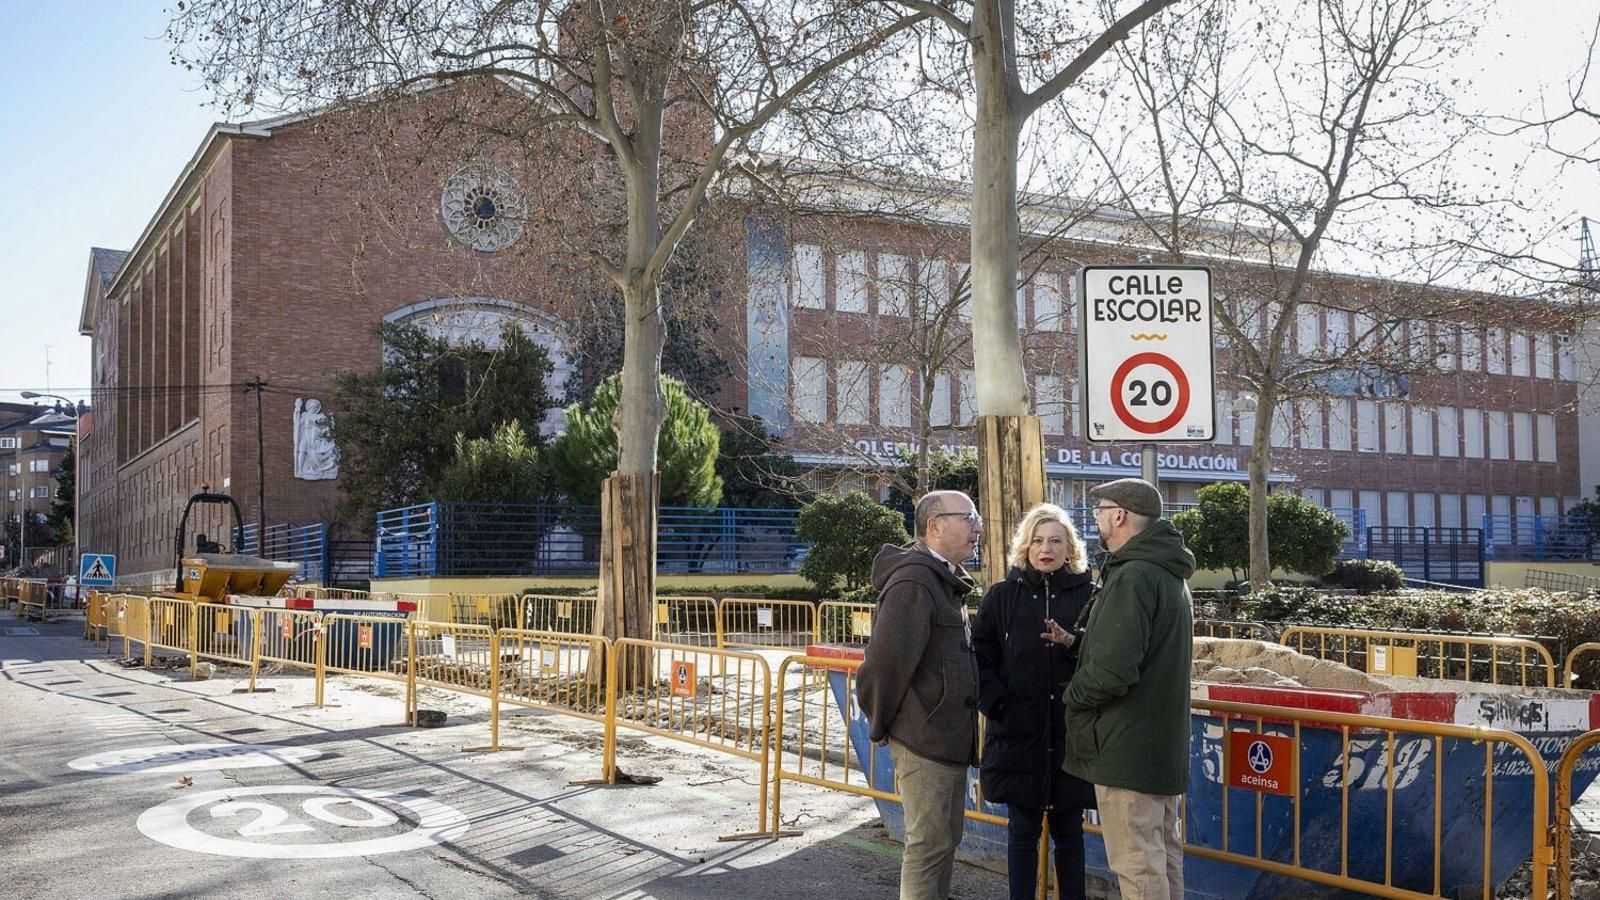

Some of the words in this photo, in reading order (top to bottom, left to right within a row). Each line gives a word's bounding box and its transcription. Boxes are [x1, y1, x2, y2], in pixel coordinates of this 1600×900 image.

[1094, 299, 1202, 322] ESCOLAR
[1129, 380, 1172, 406] 20
[1057, 449, 1082, 464] DE
[1090, 451, 1112, 466] LA
[1120, 452, 1237, 471] COSOLACIÓN
[1241, 774, 1279, 790] aceinsa
[209, 797, 400, 837] 20
